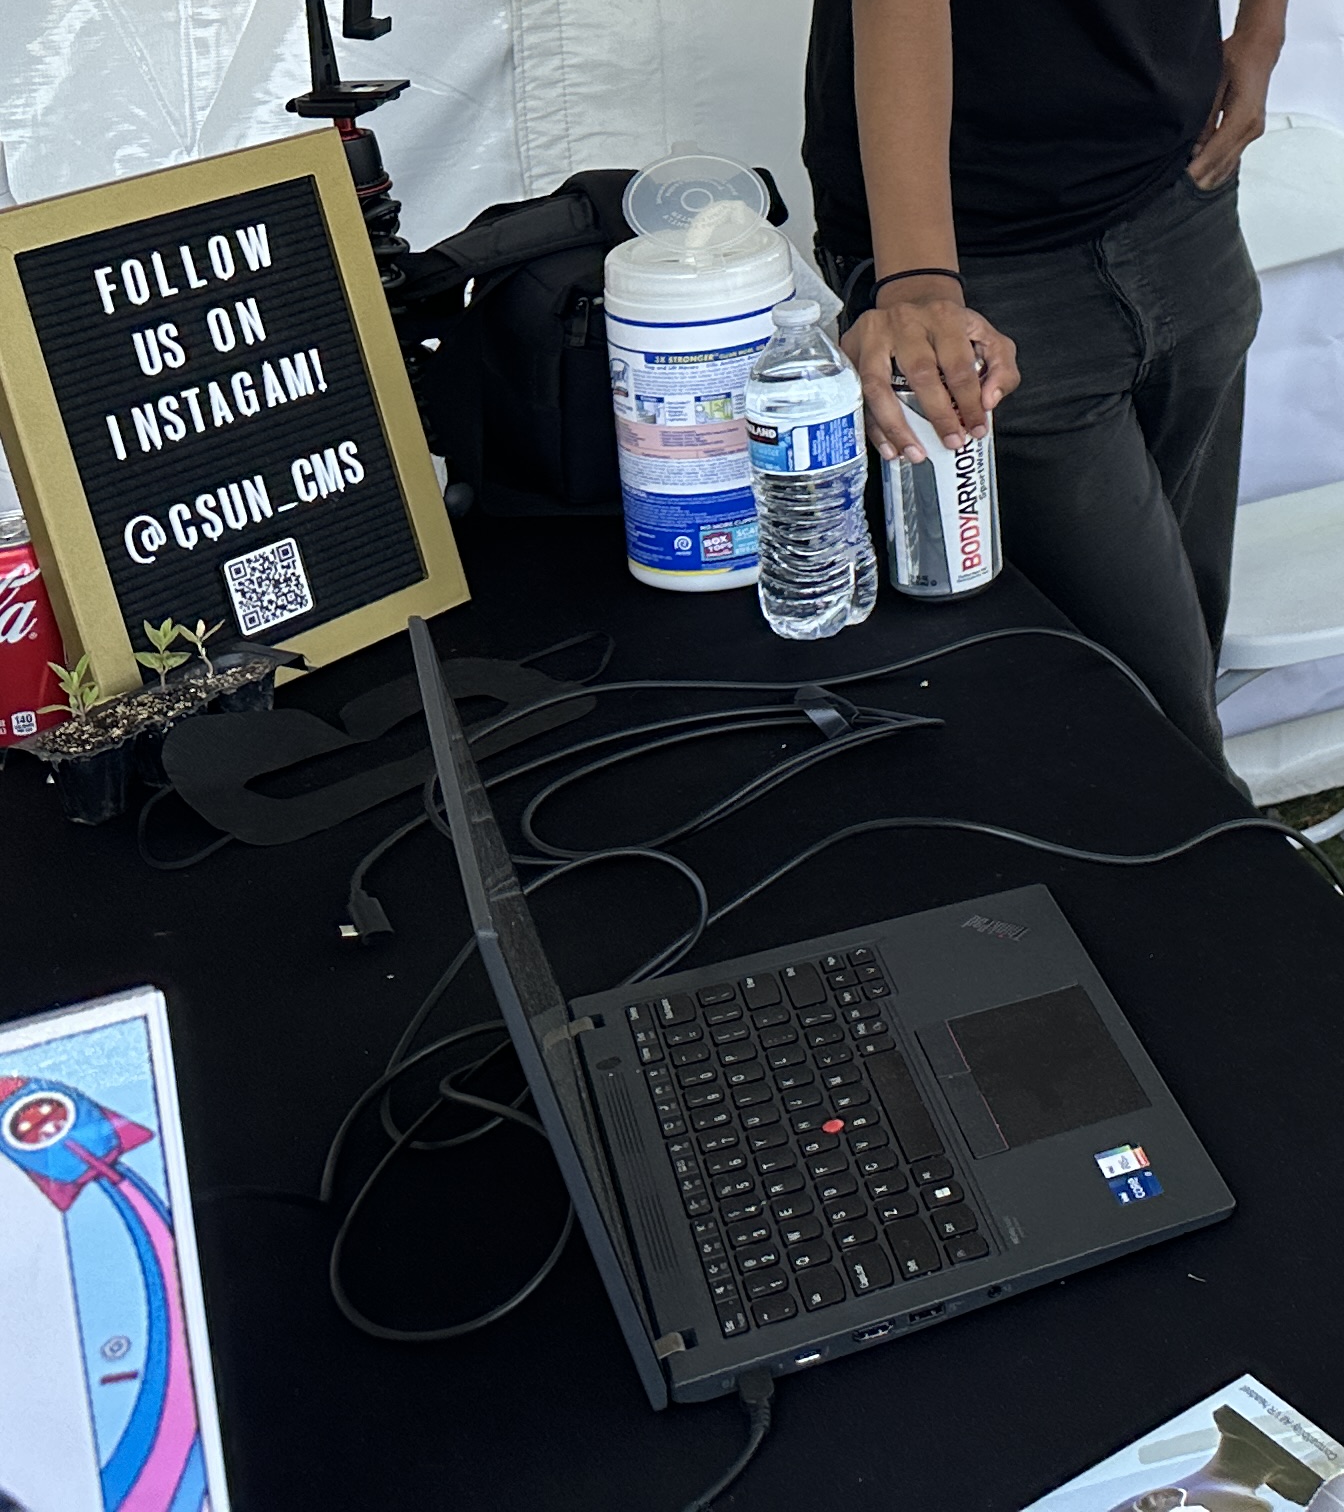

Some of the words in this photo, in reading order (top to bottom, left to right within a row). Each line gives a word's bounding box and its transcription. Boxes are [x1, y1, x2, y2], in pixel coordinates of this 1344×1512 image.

[94, 223, 271, 315] FOLLOW
[131, 323, 186, 376] US
[206, 298, 267, 353] ON
[106, 348, 328, 460] INSTAGAM!
[124, 441, 365, 564] @CSUN_CMS
[703, 535, 728, 547] BOX
[955, 437, 982, 572] BODYARMOR
[15, 714, 32, 724] 140
